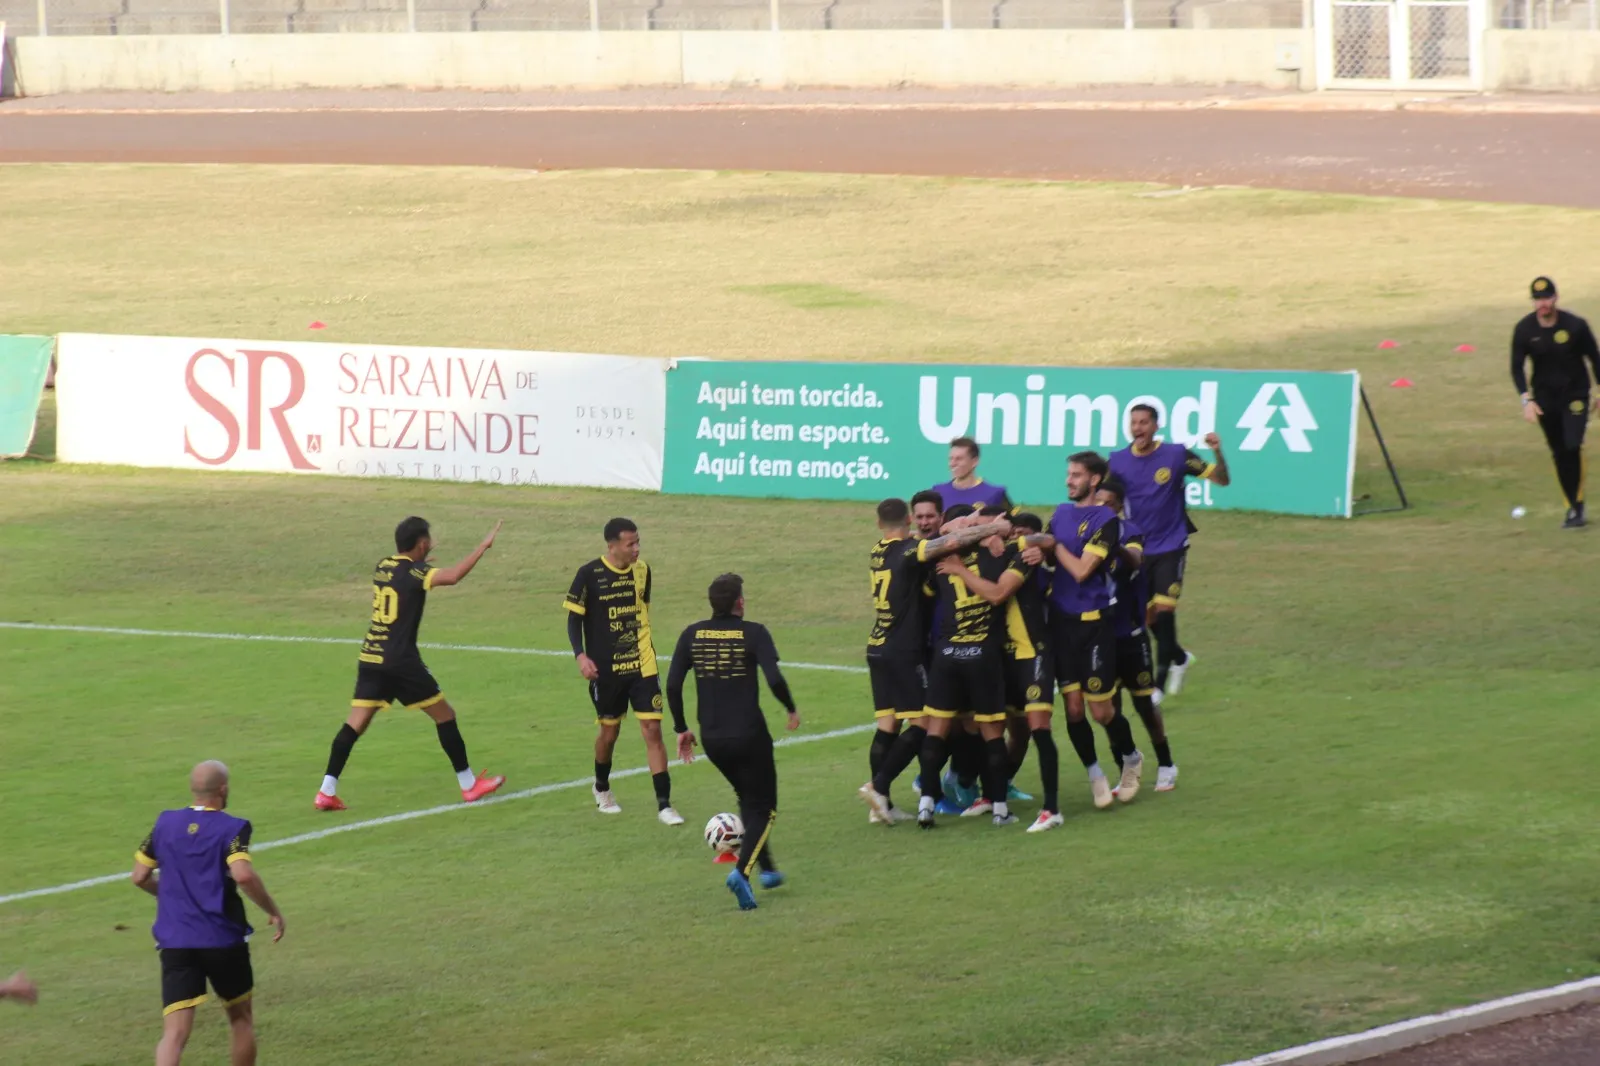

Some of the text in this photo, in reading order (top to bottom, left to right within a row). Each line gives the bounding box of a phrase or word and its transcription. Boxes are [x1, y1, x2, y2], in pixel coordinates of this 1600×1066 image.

[338, 352, 539, 401] SARAIVA DE
[184, 348, 321, 470] SR
[576, 406, 635, 420] DESDE
[697, 381, 884, 411] Aqui tem torcida.
[918, 374, 1218, 450] Unimed
[337, 406, 541, 456] REZENDE
[696, 416, 890, 450] Aqui tem esporte.
[336, 458, 540, 484] CONSTRUTORA
[694, 452, 890, 486] Aqui tem emoção.
